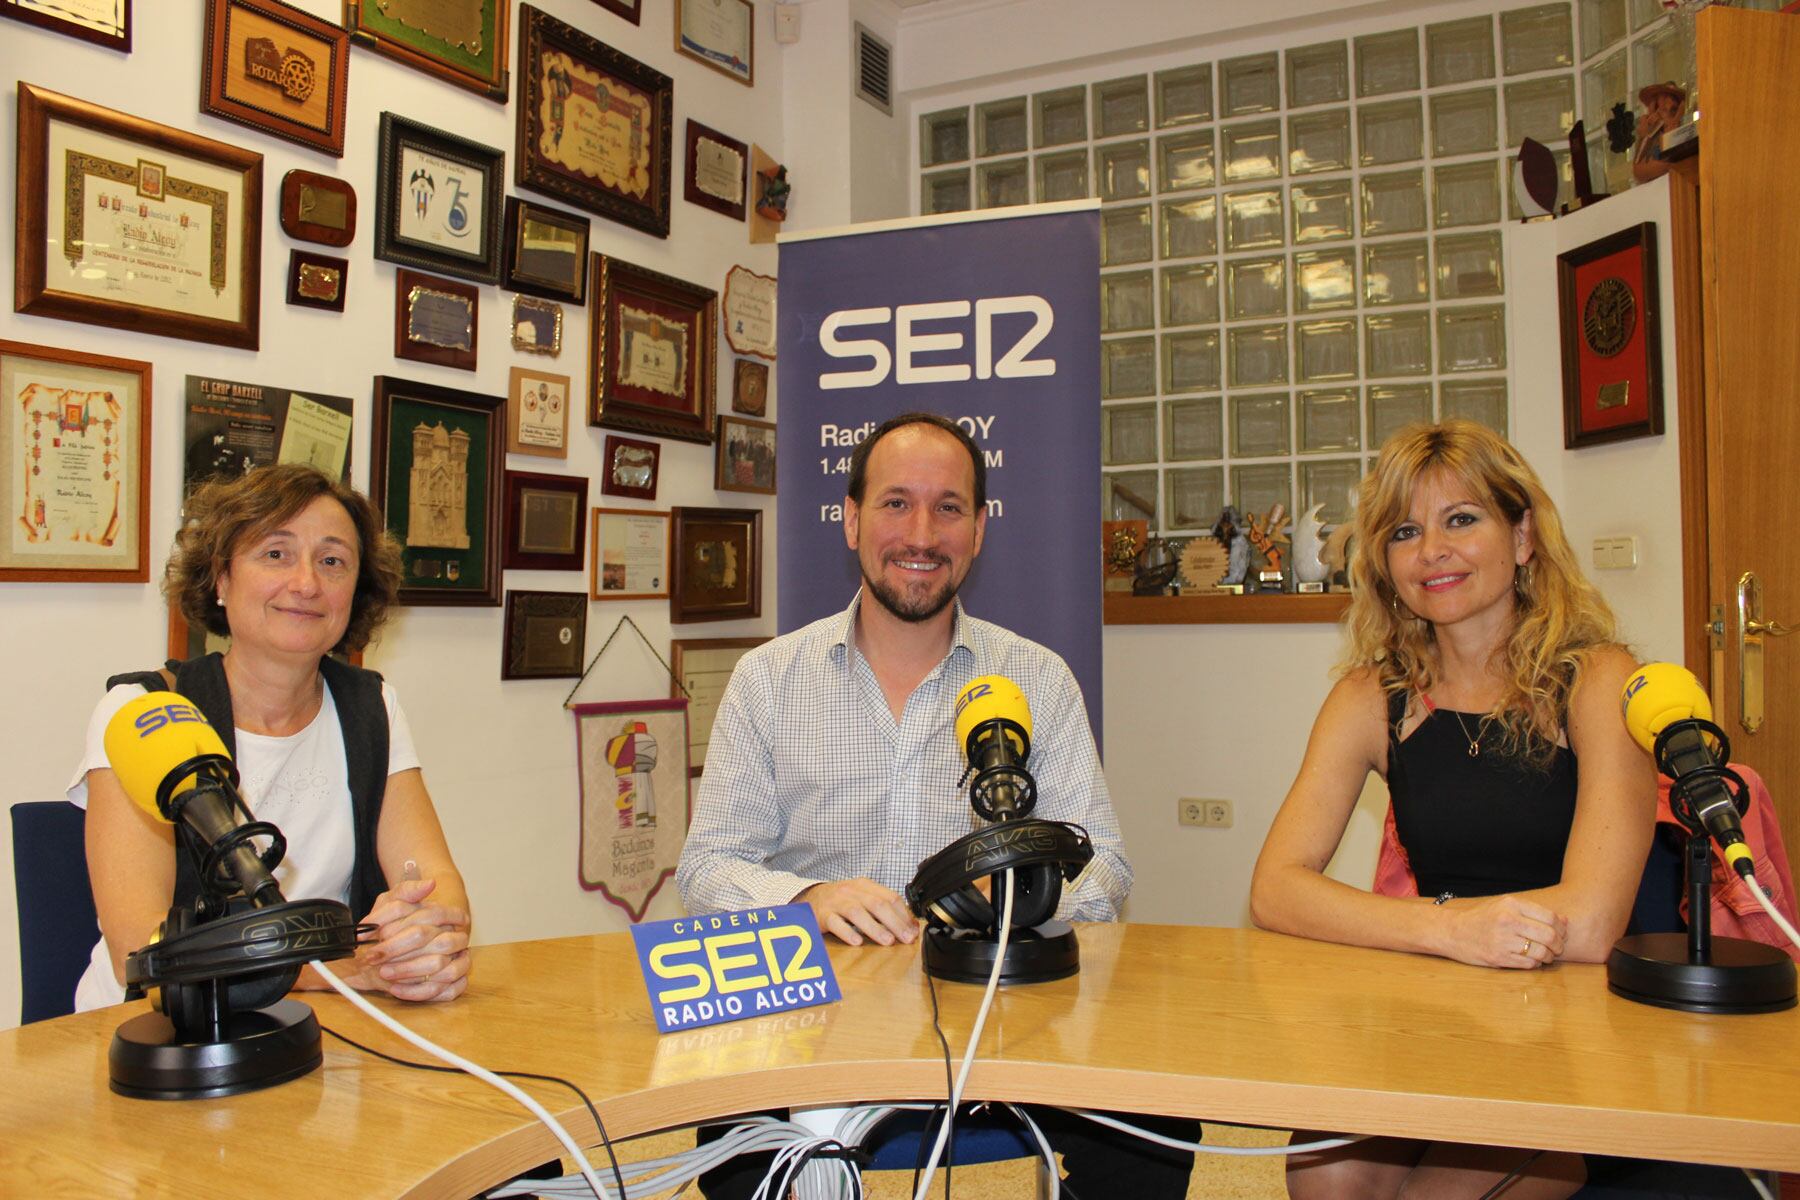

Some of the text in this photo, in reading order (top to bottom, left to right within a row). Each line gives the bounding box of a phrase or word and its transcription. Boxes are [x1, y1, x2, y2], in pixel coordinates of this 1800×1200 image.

[819, 295, 1056, 390] SER
[820, 421, 876, 447] Radi
[956, 684, 993, 719] ER
[965, 826, 1057, 872] AKG
[673, 910, 777, 934] CADENA
[649, 924, 823, 1004] SER
[663, 980, 827, 1026] RADIO ALCOY
